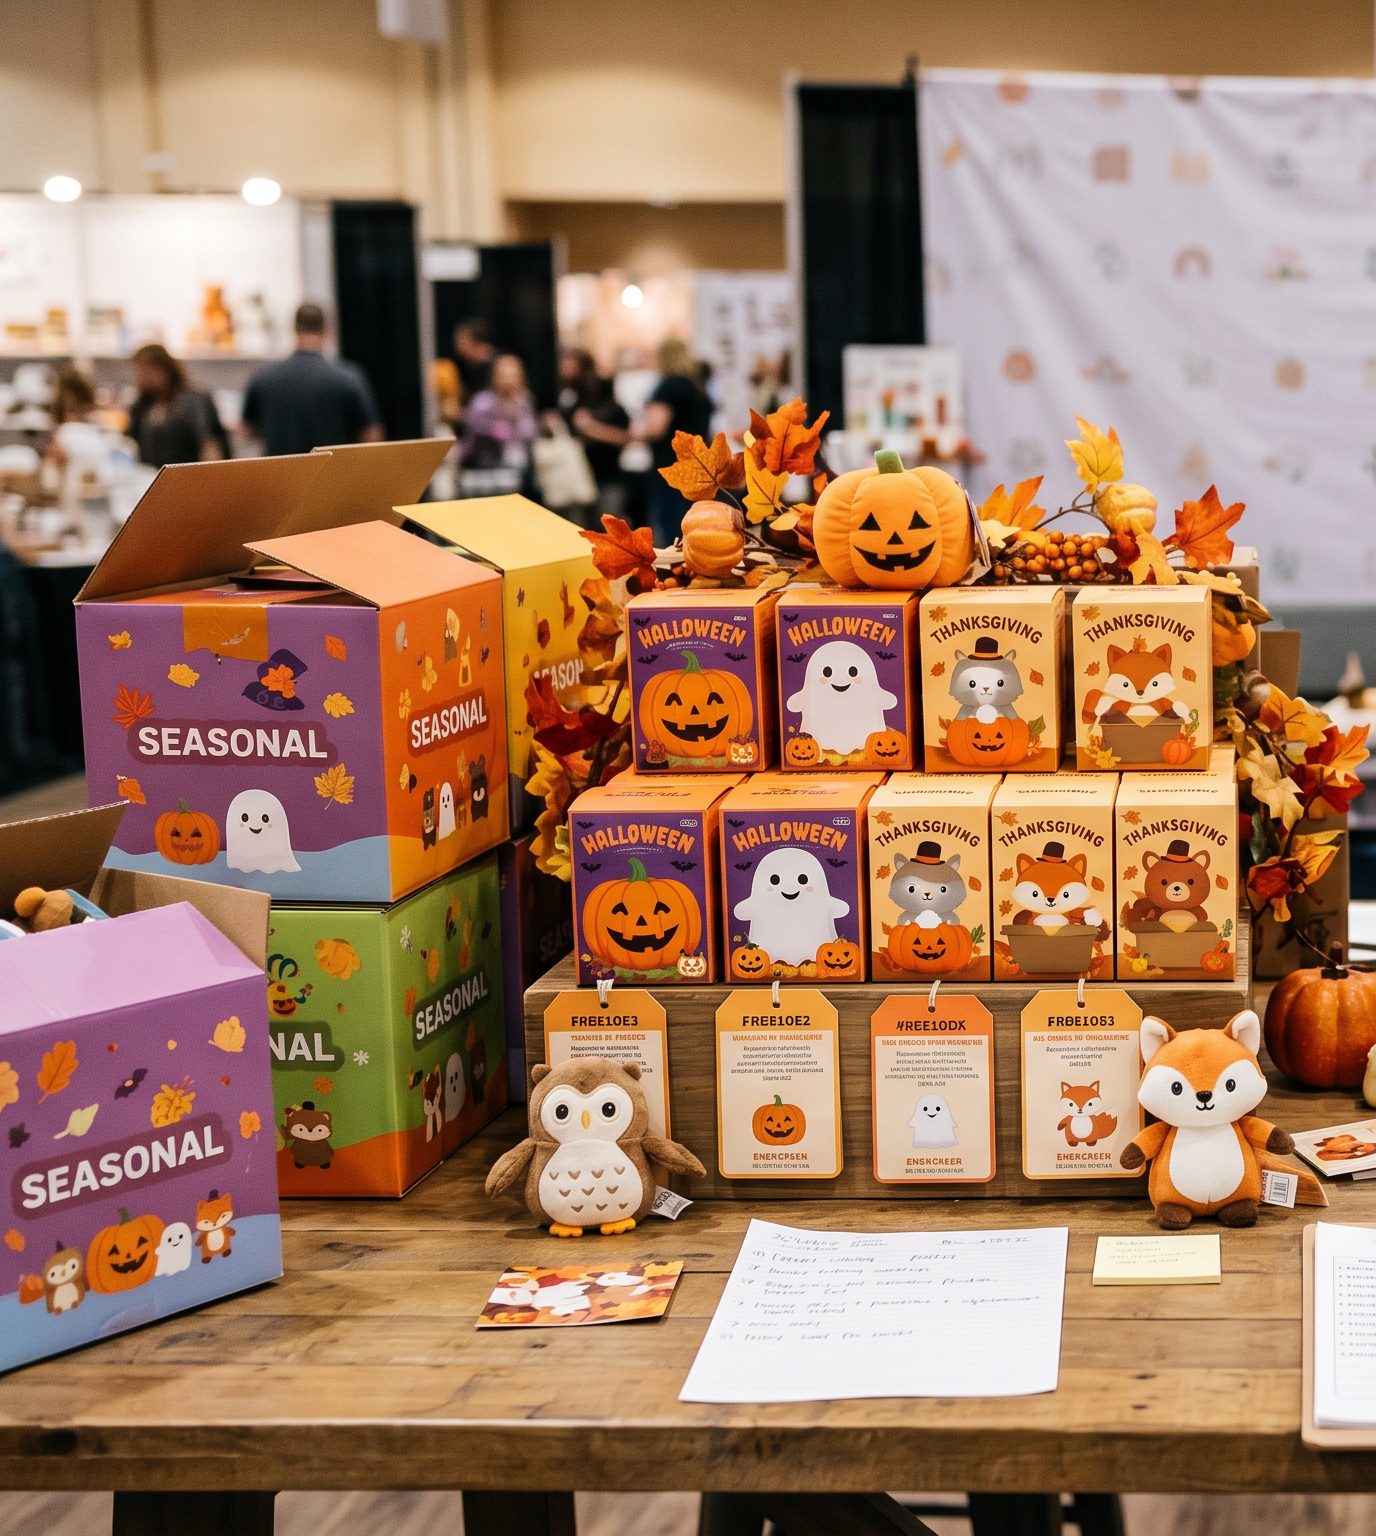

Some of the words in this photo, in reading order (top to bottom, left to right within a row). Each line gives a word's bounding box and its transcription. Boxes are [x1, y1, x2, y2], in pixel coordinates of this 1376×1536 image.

[637, 616, 747, 649] HALLOWEEN
[787, 616, 897, 647] HALLOWEEN
[930, 615, 1043, 645] THANKSGIVING
[1083, 613, 1196, 644] THANKSGIVING
[411, 695, 487, 748] SEASONAL
[138, 726, 328, 758] SEASONAL
[580, 823, 695, 855] HALLOWEEN
[732, 821, 848, 852] HALLOWEEN
[874, 820, 981, 849] THANKSGIVING
[998, 820, 1105, 849] THANKSGIVING
[1122, 818, 1229, 848] THANKSGIVING
[415, 971, 488, 1040] SEASONAL
[21, 1125, 225, 1209] SEASONAL
